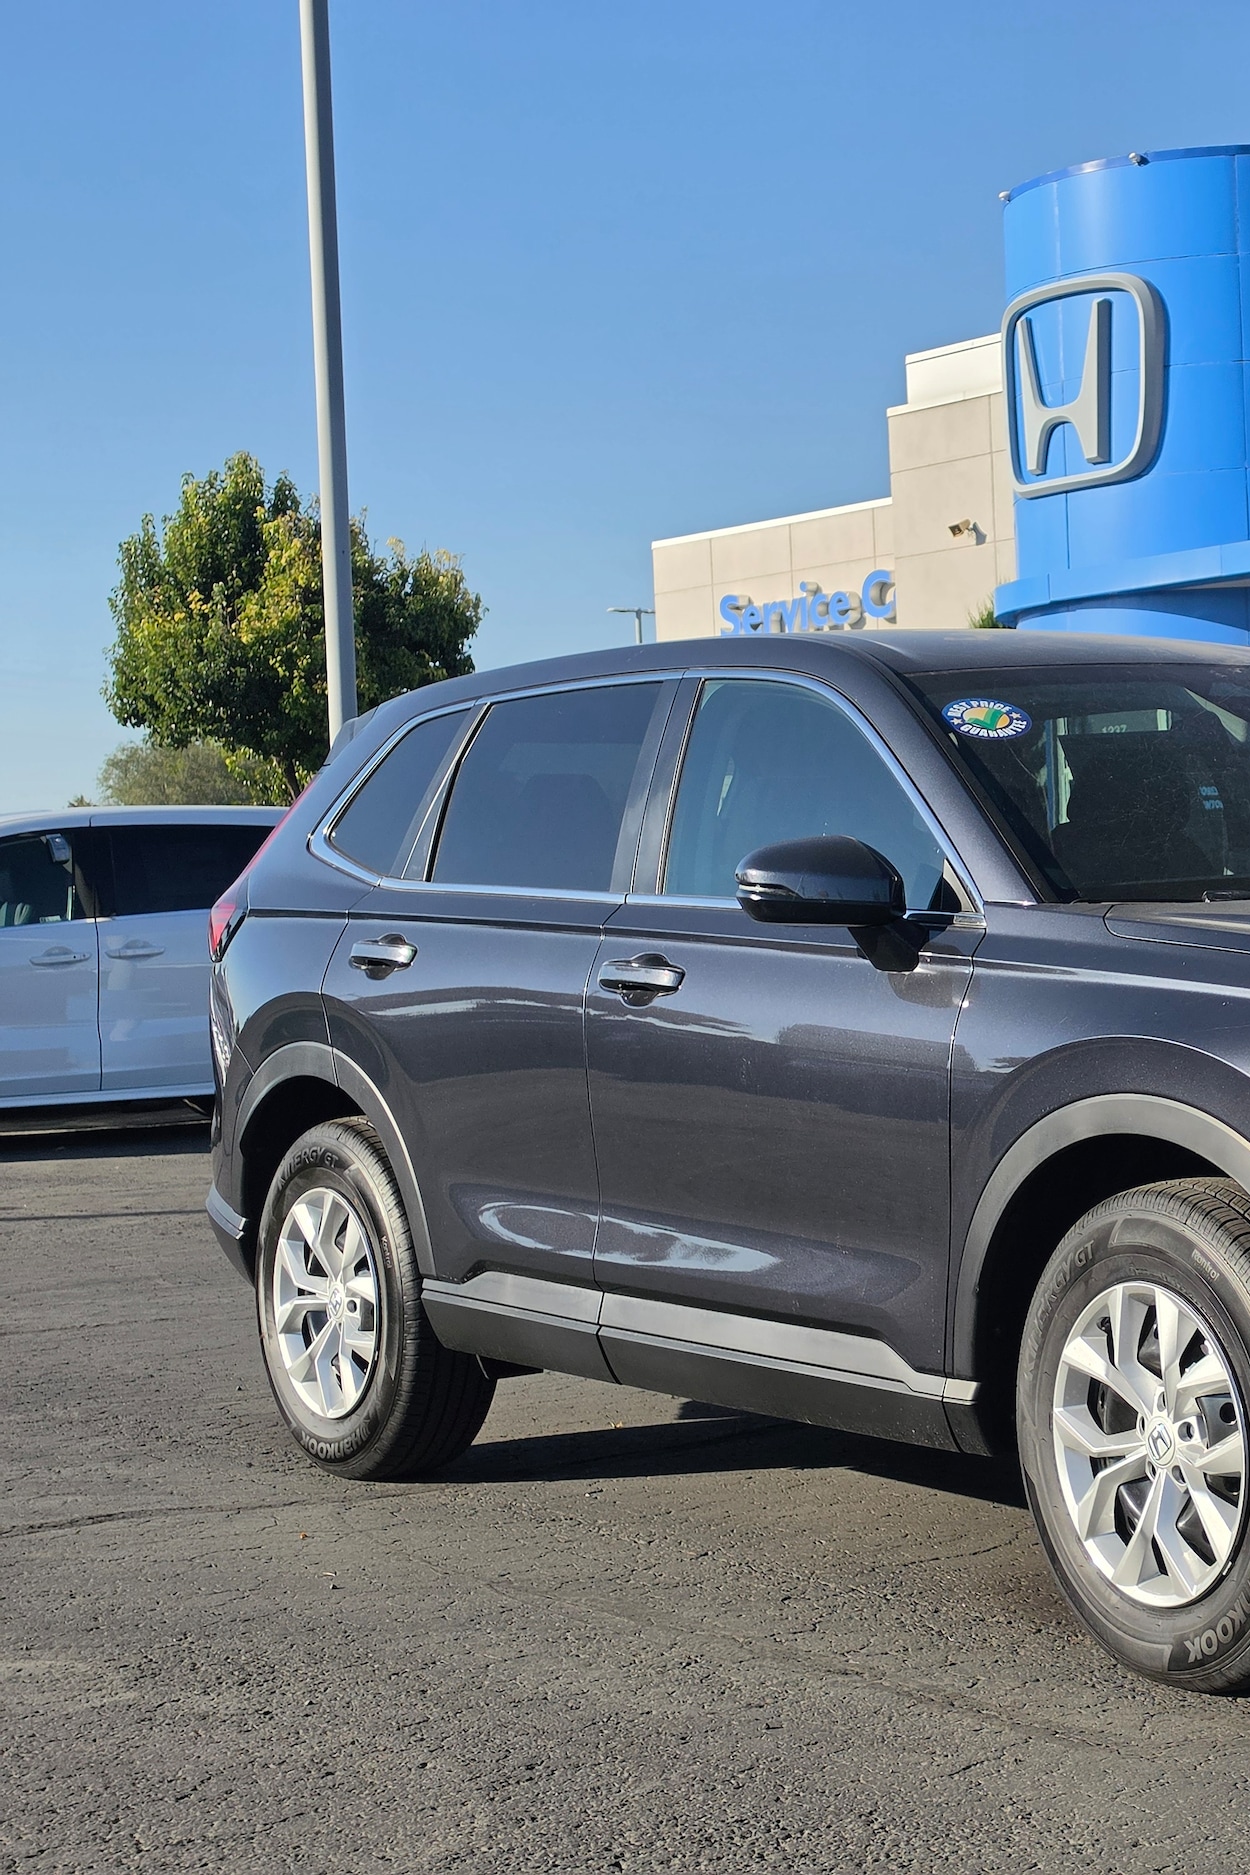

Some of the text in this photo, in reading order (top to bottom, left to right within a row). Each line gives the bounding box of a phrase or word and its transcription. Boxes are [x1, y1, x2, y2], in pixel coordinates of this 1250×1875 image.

[719, 569, 897, 636] Service C
[947, 700, 1013, 717] BEST PRICE
[960, 719, 1027, 738] GUARANTEE
[1074, 1240, 1095, 1268] GT
